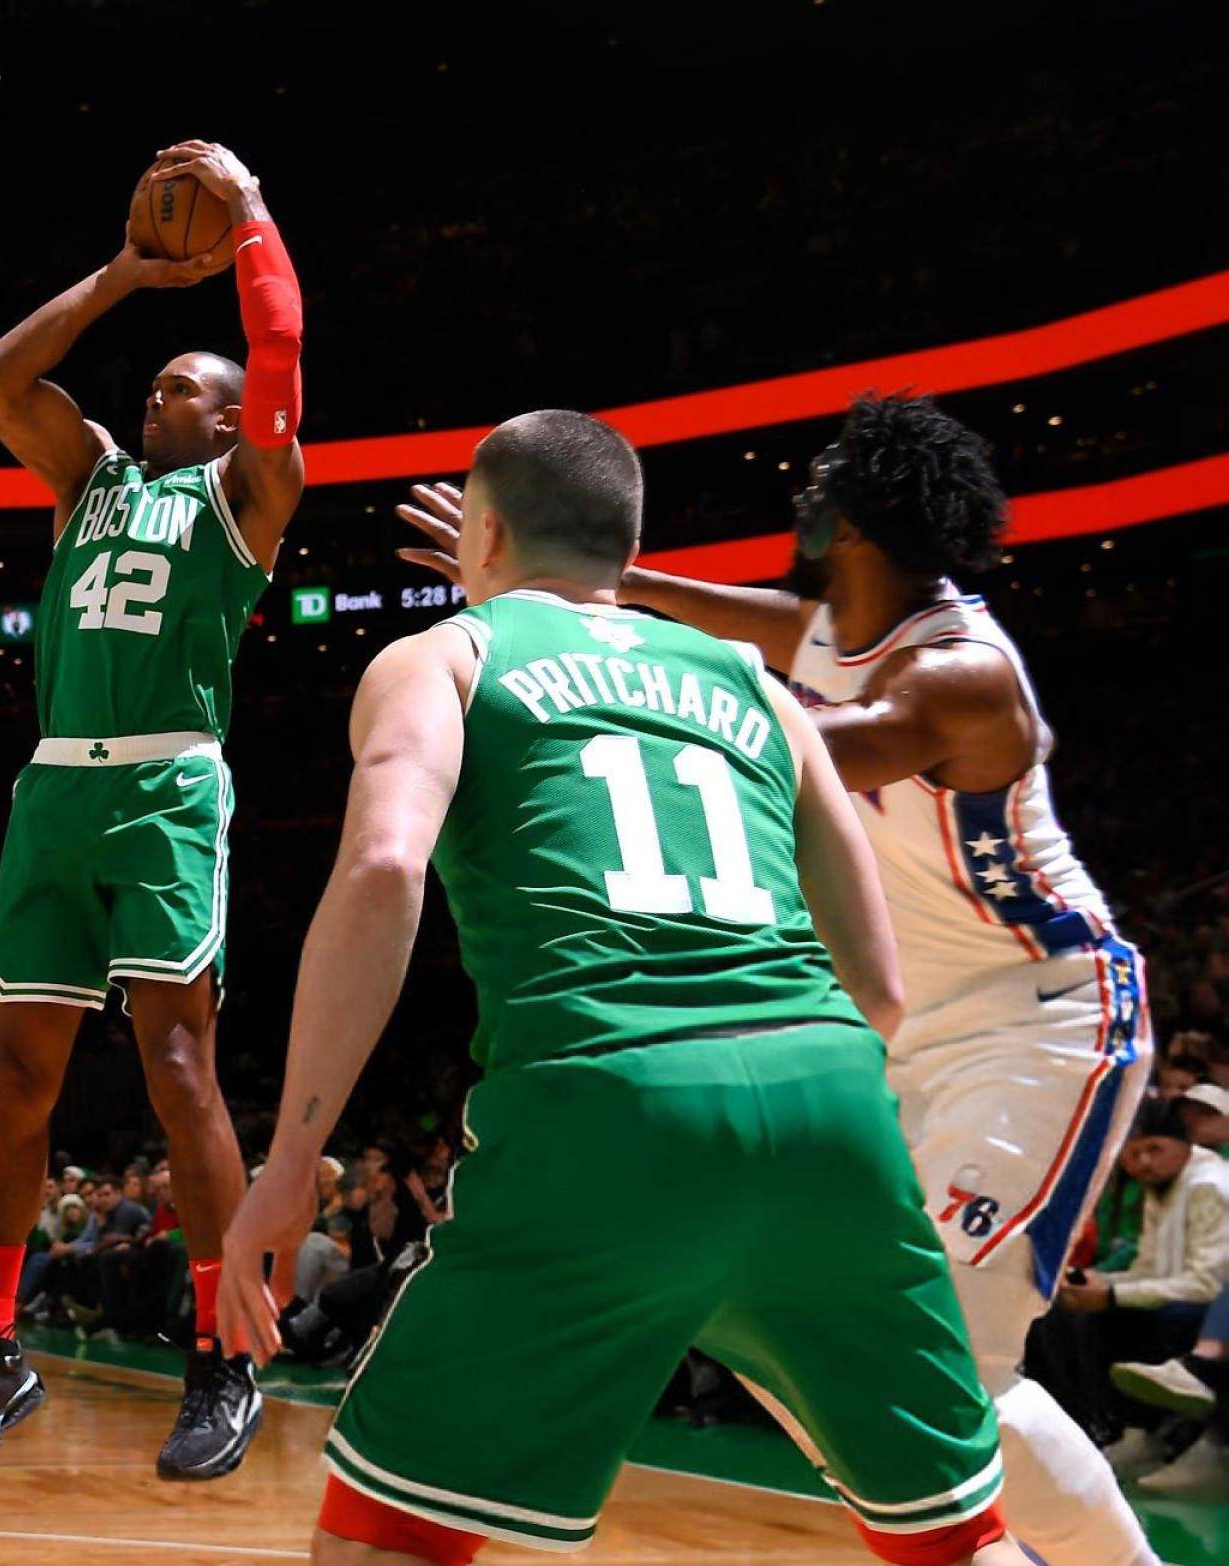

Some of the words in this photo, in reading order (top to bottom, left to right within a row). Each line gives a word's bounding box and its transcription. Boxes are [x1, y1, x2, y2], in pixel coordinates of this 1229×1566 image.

[75, 482, 198, 552] BOSTON
[70, 551, 172, 635] 42
[294, 593, 327, 617] TD
[334, 591, 383, 612] Bank
[451, 584, 467, 605] P
[499, 652, 771, 760] PRITCHARD
[579, 734, 777, 925] 11
[937, 1184, 999, 1237] 76
